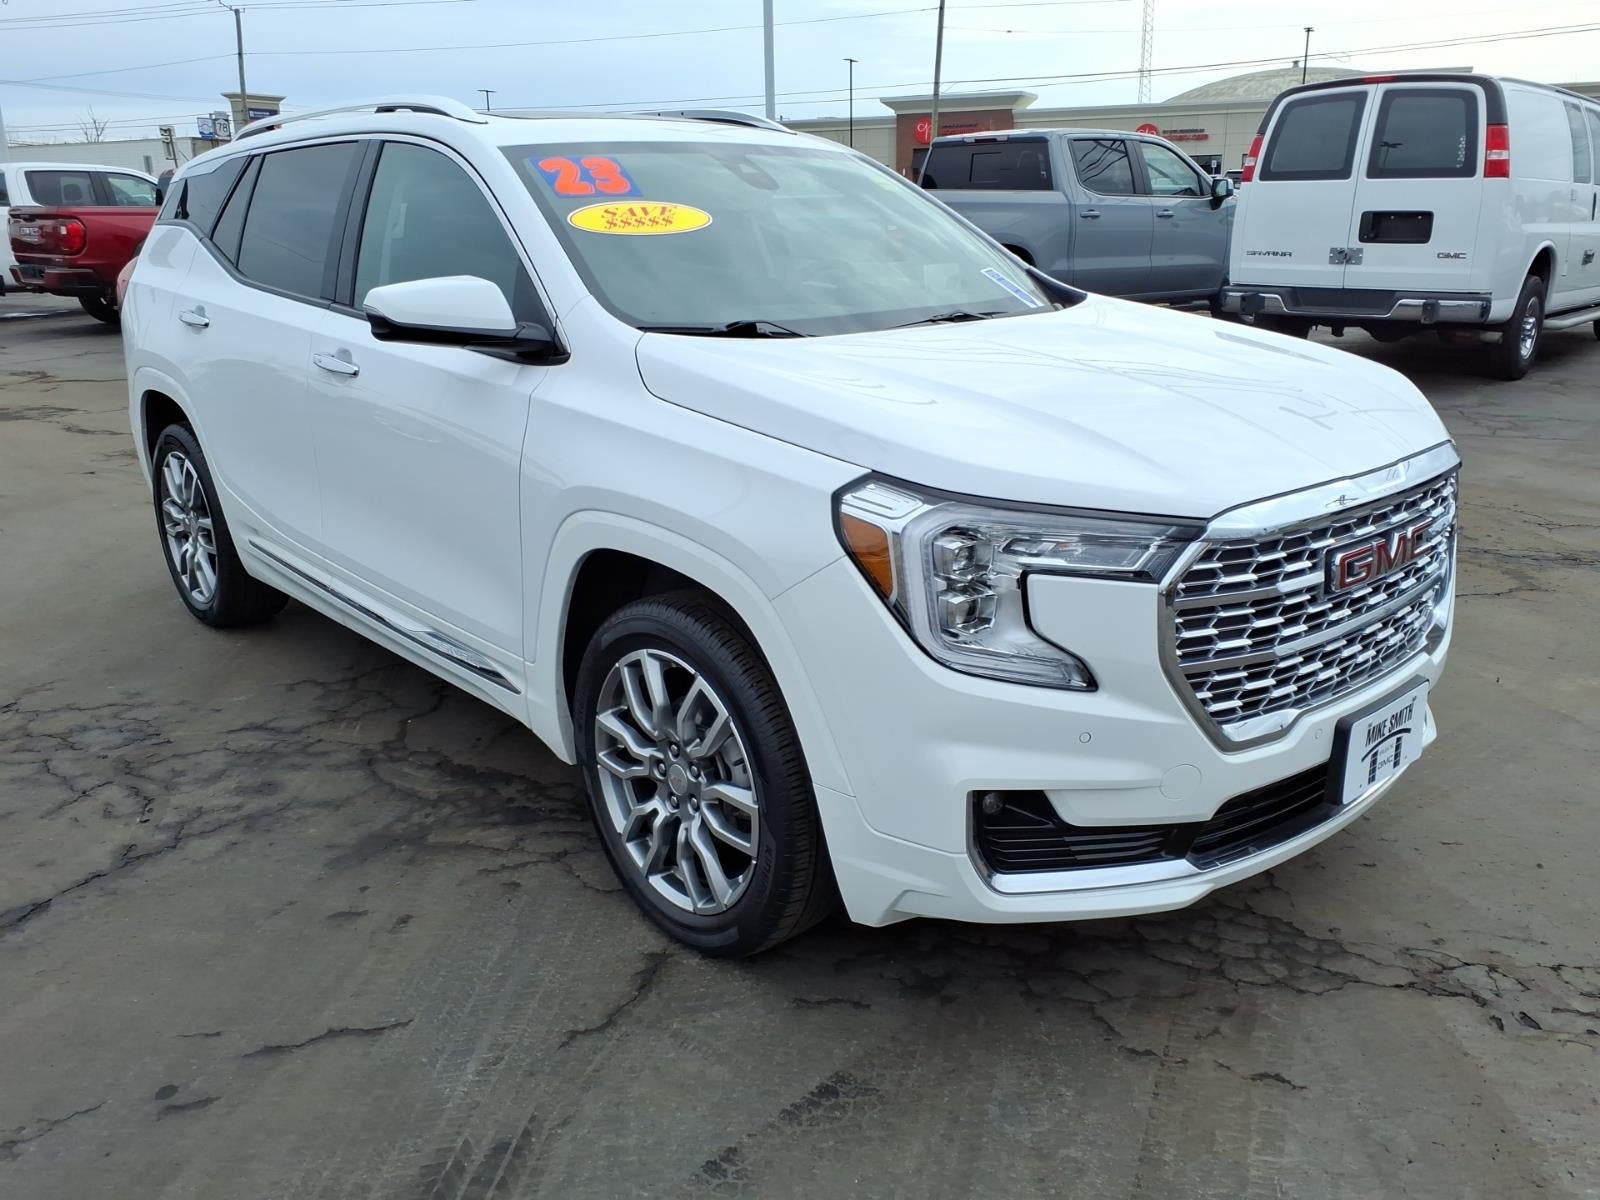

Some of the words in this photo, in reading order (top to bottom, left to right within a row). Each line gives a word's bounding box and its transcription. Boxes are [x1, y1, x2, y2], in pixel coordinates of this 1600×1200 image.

[217, 122, 229, 132] 78
[539, 156, 631, 196] 23
[601, 205, 677, 218] SAVE
[1436, 252, 1467, 260] GMC
[1332, 518, 1433, 592] GMC
[1365, 718, 1387, 747] MIKE
[1388, 702, 1415, 734] SMITH
